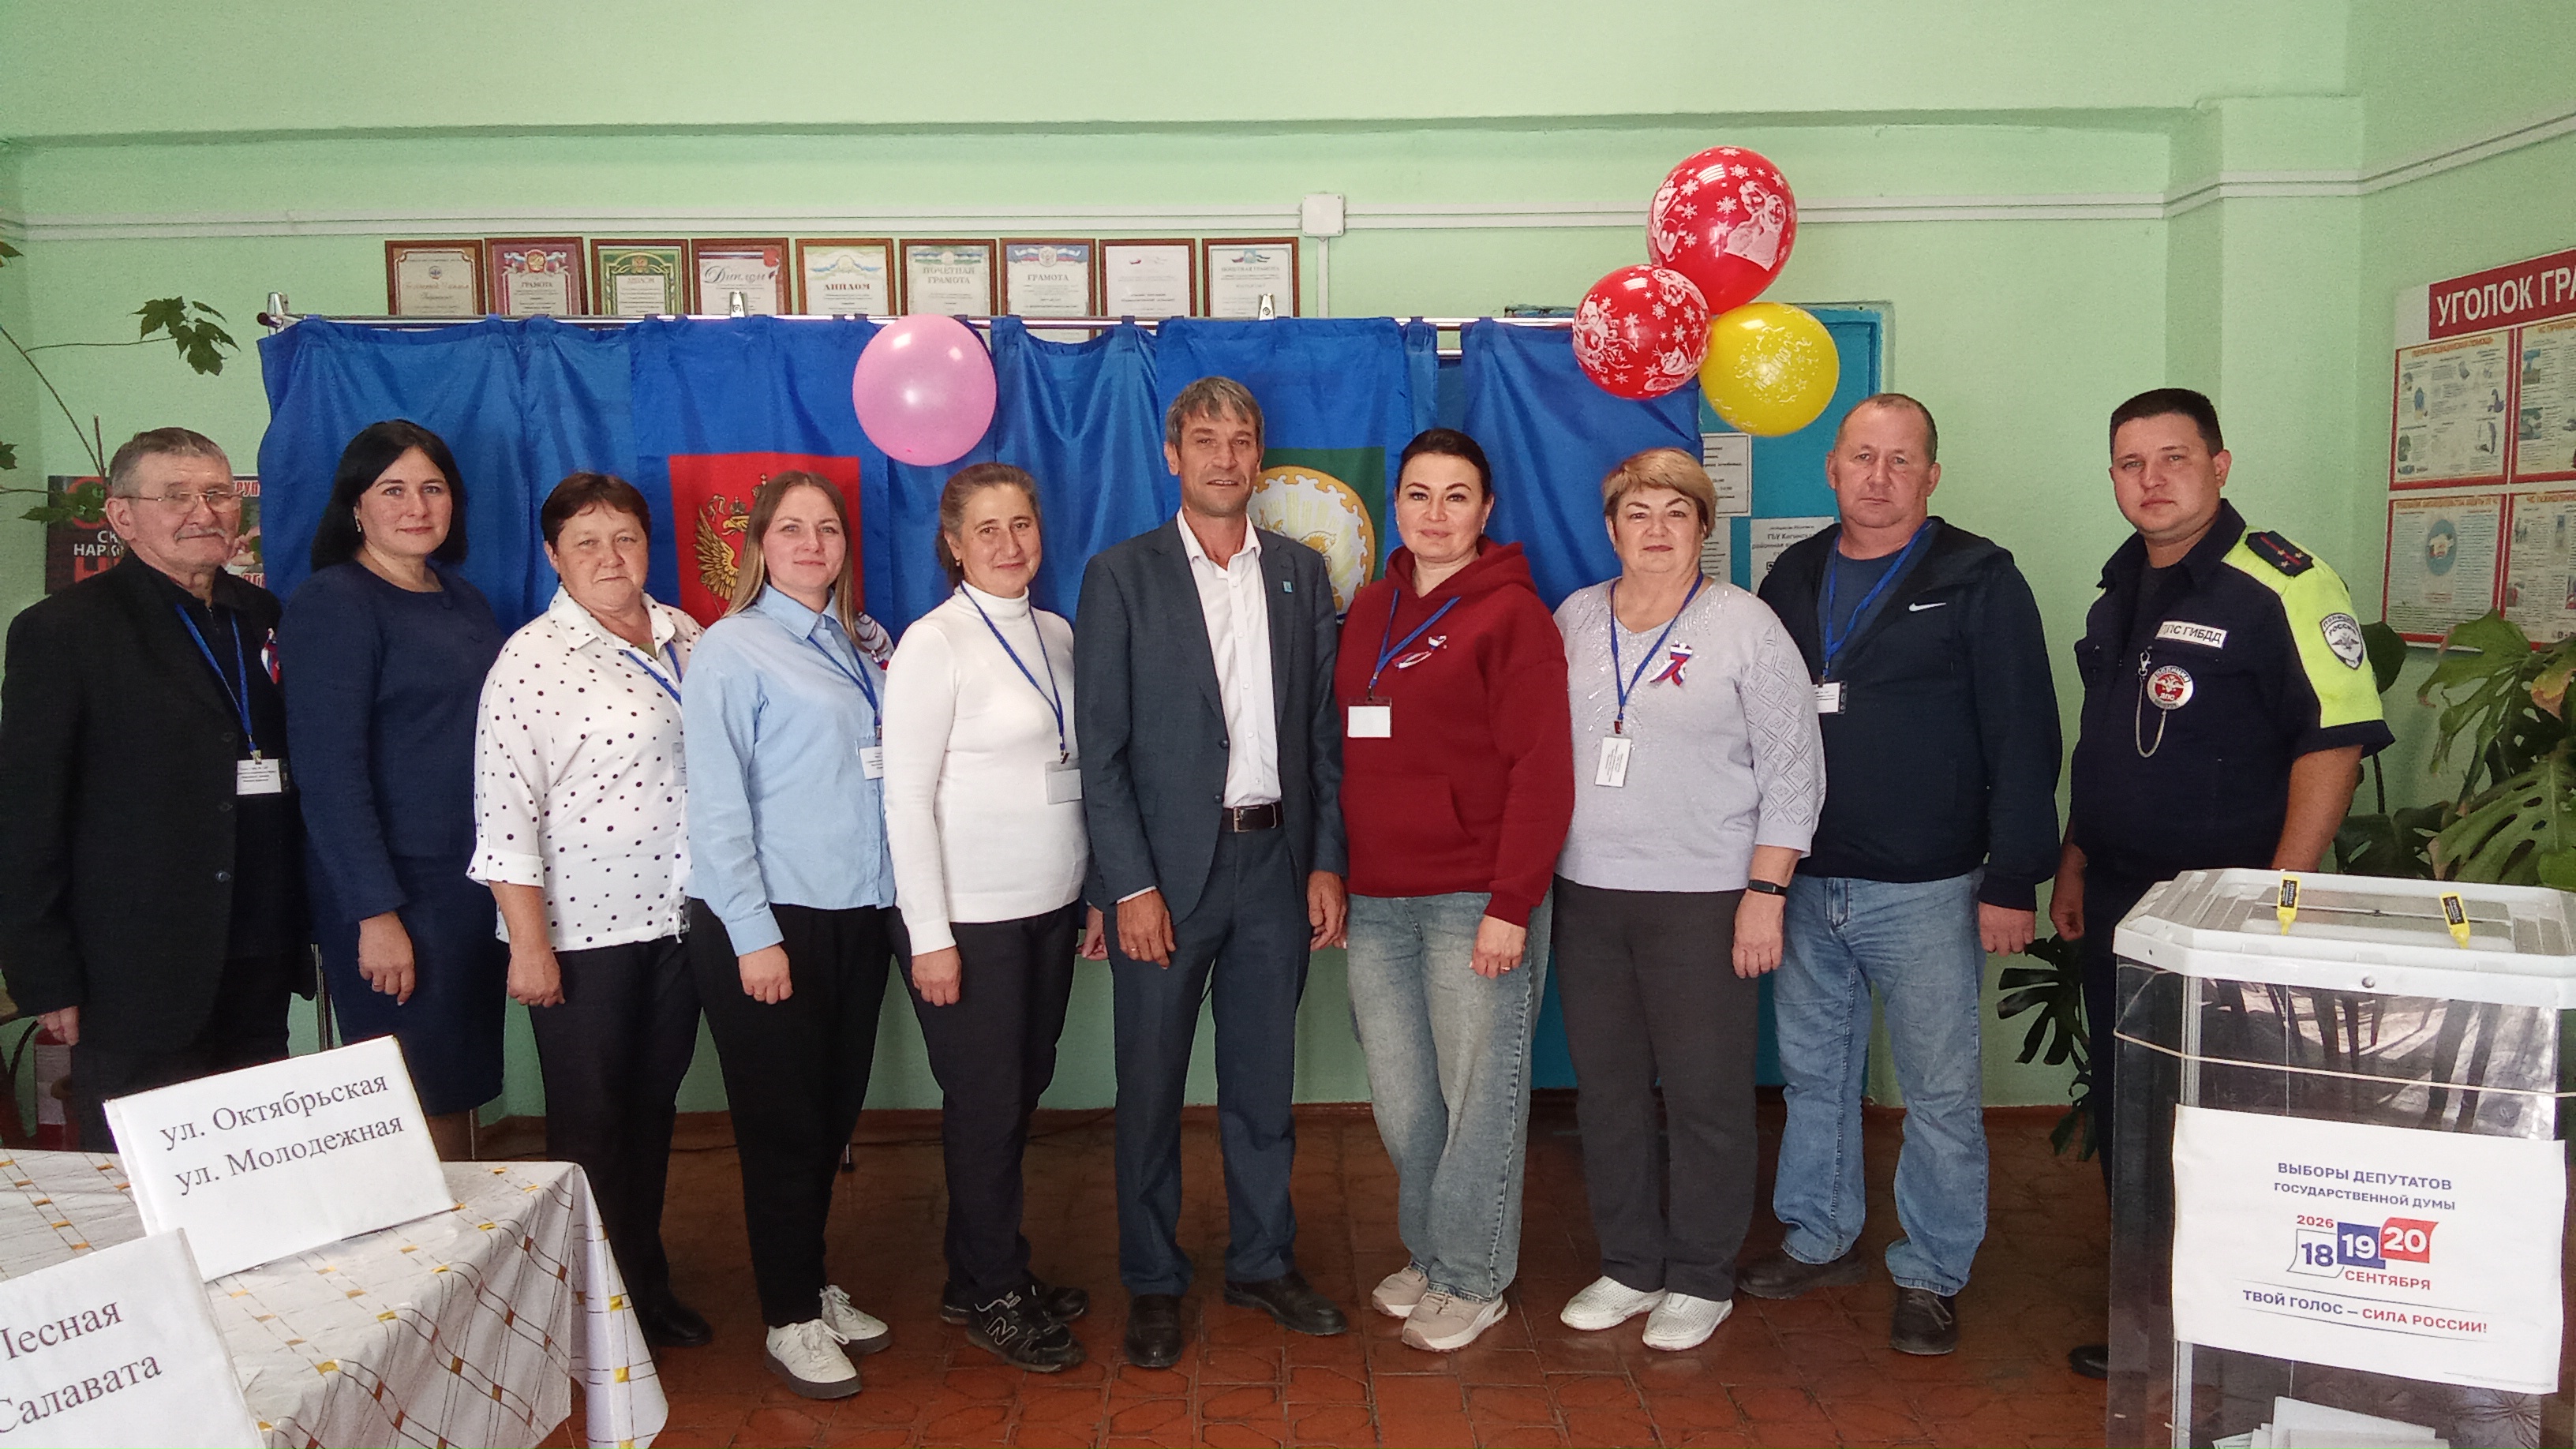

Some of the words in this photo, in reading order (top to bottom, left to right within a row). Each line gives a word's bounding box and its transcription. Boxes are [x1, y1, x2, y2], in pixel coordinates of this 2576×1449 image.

[2436, 275, 2534, 327] УГОЛОК
[2183, 627, 2222, 645] ГИБДД
[159, 1121, 206, 1151] ул.
[212, 1075, 389, 1131] Октябрьская
[174, 1166, 220, 1196] ул.
[224, 1116, 405, 1177] Молодежная
[2278, 1162, 2349, 1181] ВЫБОРЫ
[2353, 1170, 2452, 1190] ДЕПУТАТОВ
[2274, 1182, 2409, 1206] ГОСУДАРСТВЕННОЙ
[2412, 1197, 2455, 1211] ДУМЫ
[2297, 1215, 2334, 1229] 2026
[2301, 1241, 2334, 1267] 18
[2342, 1233, 2376, 1260] 19
[2383, 1226, 2428, 1253] 20
[2344, 1269, 2432, 1290] СЕНТЯБРЯ
[2242, 1289, 2286, 1306] ТВОЙ
[2290, 1295, 2344, 1316] ГОЛОС
[2361, 1308, 2408, 1325] СИЛА
[2412, 1315, 2488, 1334] РОССИИ!
[0, 1355, 163, 1434] Салавата
